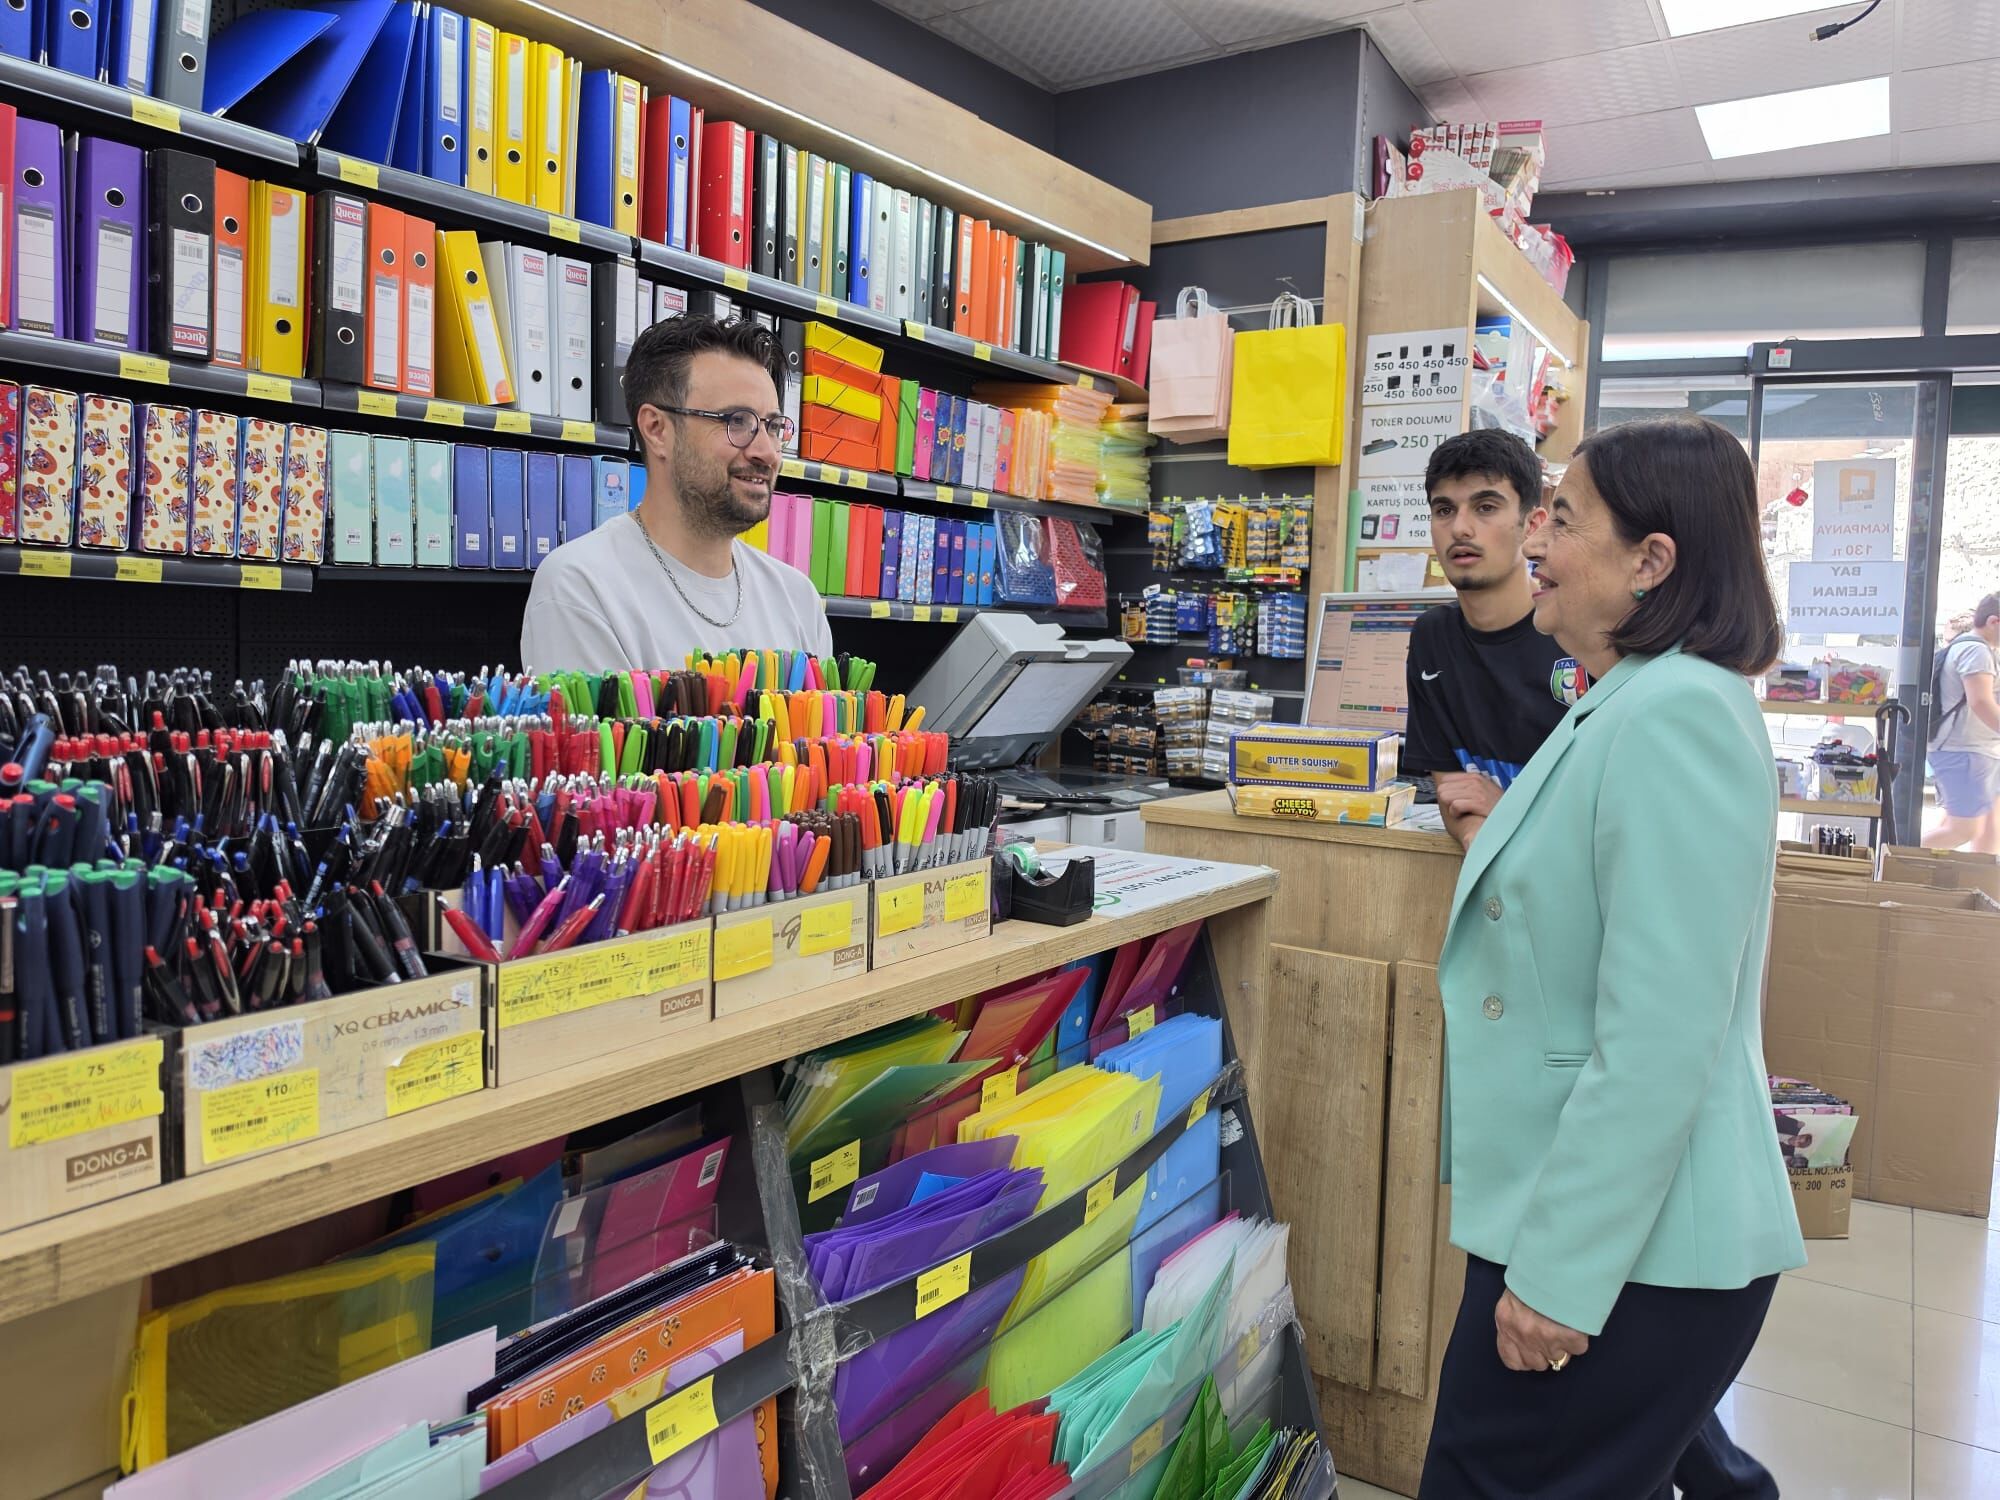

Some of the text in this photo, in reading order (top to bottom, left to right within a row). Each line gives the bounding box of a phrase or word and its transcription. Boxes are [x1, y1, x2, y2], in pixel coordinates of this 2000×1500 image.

[335, 206, 362, 221] Queen
[523, 257, 544, 272] Queen
[566, 268, 587, 281] Queen
[664, 295, 683, 308] Queen
[21, 321, 50, 331] MARKA
[97, 331, 125, 342] MARKA
[174, 330, 207, 346] Queen
[1374, 357, 1468, 371] 550 450 450 450
[408, 370, 430, 385] Queen
[1363, 384, 1457, 398] 250 450 600 600
[1371, 415, 1452, 427] TONER DOLUMU
[1400, 434, 1429, 448] 250
[1403, 483, 1415, 491] VE
[1367, 498, 1428, 507] KARTUŞ DOLU
[1557, 661, 1574, 669] ITAL
[1267, 756, 1339, 768] BUTTER SQUISHY
[1275, 799, 1313, 809] CHEESE
[679, 939, 692, 949] 115
[611, 953, 625, 962] 115
[835, 949, 863, 962] DONG-A
[663, 993, 701, 1013] DONG-A
[334, 999, 461, 1039] XQ CERAMICS
[439, 1044, 457, 1056] 110
[88, 1064, 105, 1077] 75
[266, 1084, 288, 1098] 110
[74, 1143, 147, 1177] DONG-A
[1790, 1167, 1812, 1176] ODEL
[1805, 1180, 1822, 1190] 300
[1830, 1179, 1846, 1189] PCS
